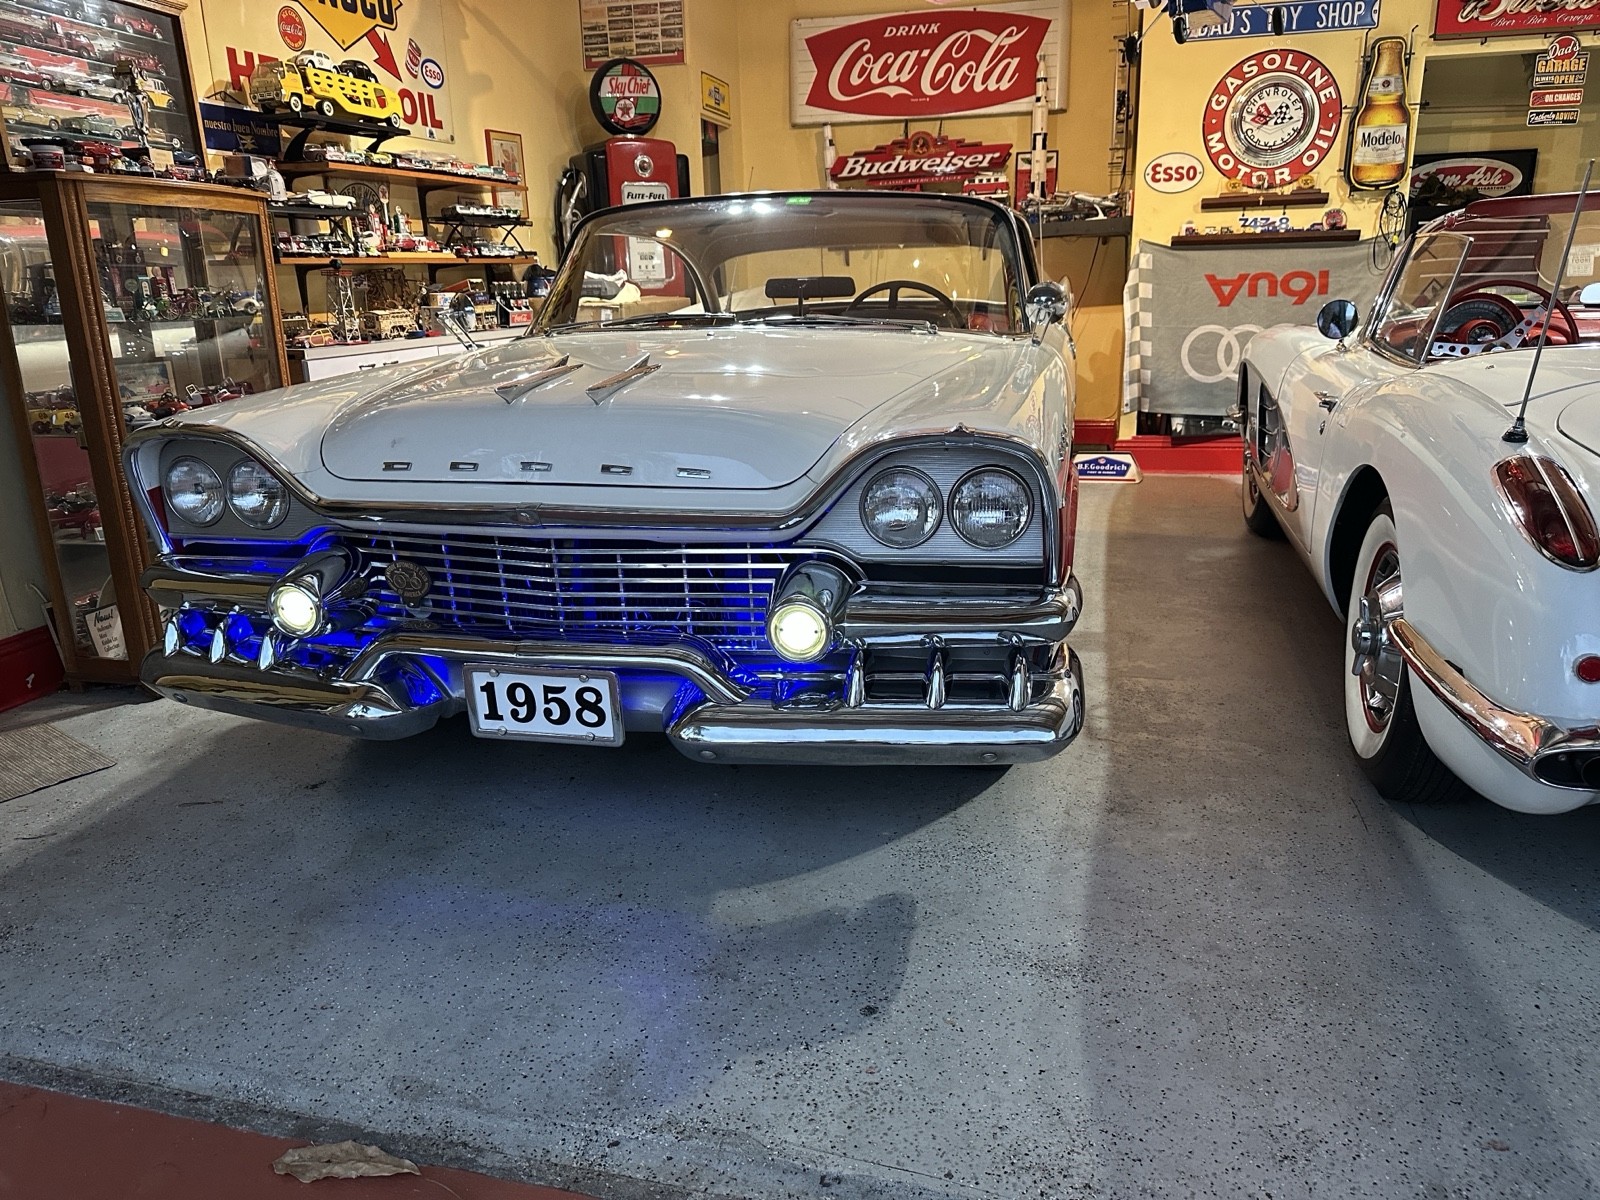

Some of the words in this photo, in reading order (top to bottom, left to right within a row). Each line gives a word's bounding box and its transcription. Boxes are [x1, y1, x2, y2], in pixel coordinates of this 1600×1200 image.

[1316, 2, 1366, 28] SHOP
[1491, 18, 1516, 27] Beer
[1523, 14, 1548, 25] Bier
[1556, 12, 1594, 26] Cerveza
[884, 23, 941, 38] DRINK
[1547, 41, 1580, 59] Dad's
[828, 26, 1030, 101] Coca-Cola
[1538, 59, 1587, 73] GARAGE
[608, 77, 627, 96] Sky
[627, 76, 651, 95] Chief
[1211, 53, 1336, 111] GASOLINE
[1554, 74, 1575, 84] OPEN
[1245, 87, 1302, 114] CHEVROLET
[1554, 92, 1581, 101] CHANGES
[397, 88, 444, 130] OIL
[1555, 111, 1577, 121] ADVICE
[232, 118, 251, 134] buen
[250, 120, 279, 137] Nombre
[1361, 131, 1401, 148] Modelo
[838, 150, 1000, 178] Budweiser
[1207, 131, 1292, 188] MOTOR
[1302, 123, 1337, 167] OIL
[1460, 166, 1503, 186] Ash
[1203, 269, 1330, 307] Audi
[480, 681, 607, 728] 1958
